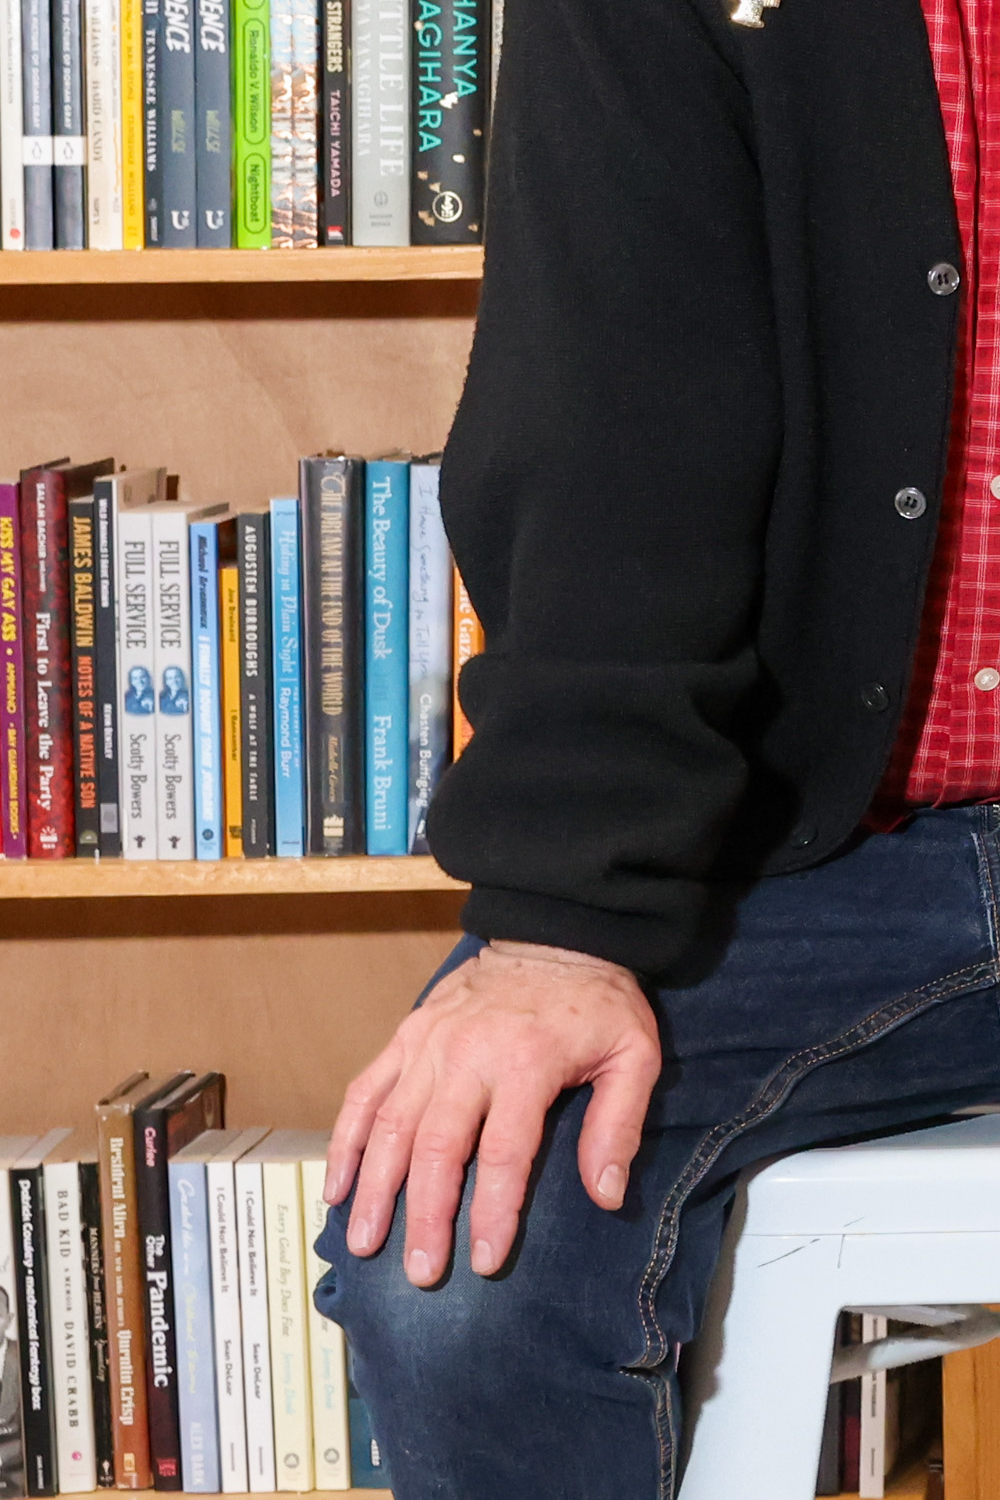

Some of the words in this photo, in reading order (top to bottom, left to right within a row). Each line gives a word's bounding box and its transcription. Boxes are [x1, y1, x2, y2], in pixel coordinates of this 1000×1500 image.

[328, 1, 342, 72] STRANGERS
[331, 90, 340, 135] TAICHI
[331, 141, 340, 197] YAMADA
[373, 476, 390, 514] The
[73, 517, 92, 568] JAMES
[159, 541, 180, 578] FULL
[368, 518, 389, 580] Beauty
[75, 573, 93, 646] BALDWIN
[161, 584, 181, 648] SERVICE
[373, 585, 391, 606] of
[373, 612, 390, 659] Dusk
[163, 734, 182, 771] Scotty
[373, 716, 391, 772] Frank
[165, 775, 182, 819] Bowers
[374, 776, 390, 830] Bruni
[57, 1191, 70, 1221] BAD
[59, 1229, 71, 1257] KID
[64, 1322, 76, 1368] DAVID
[147, 1271, 173, 1387] Pandemic
[67, 1375, 80, 1428] CRABB
